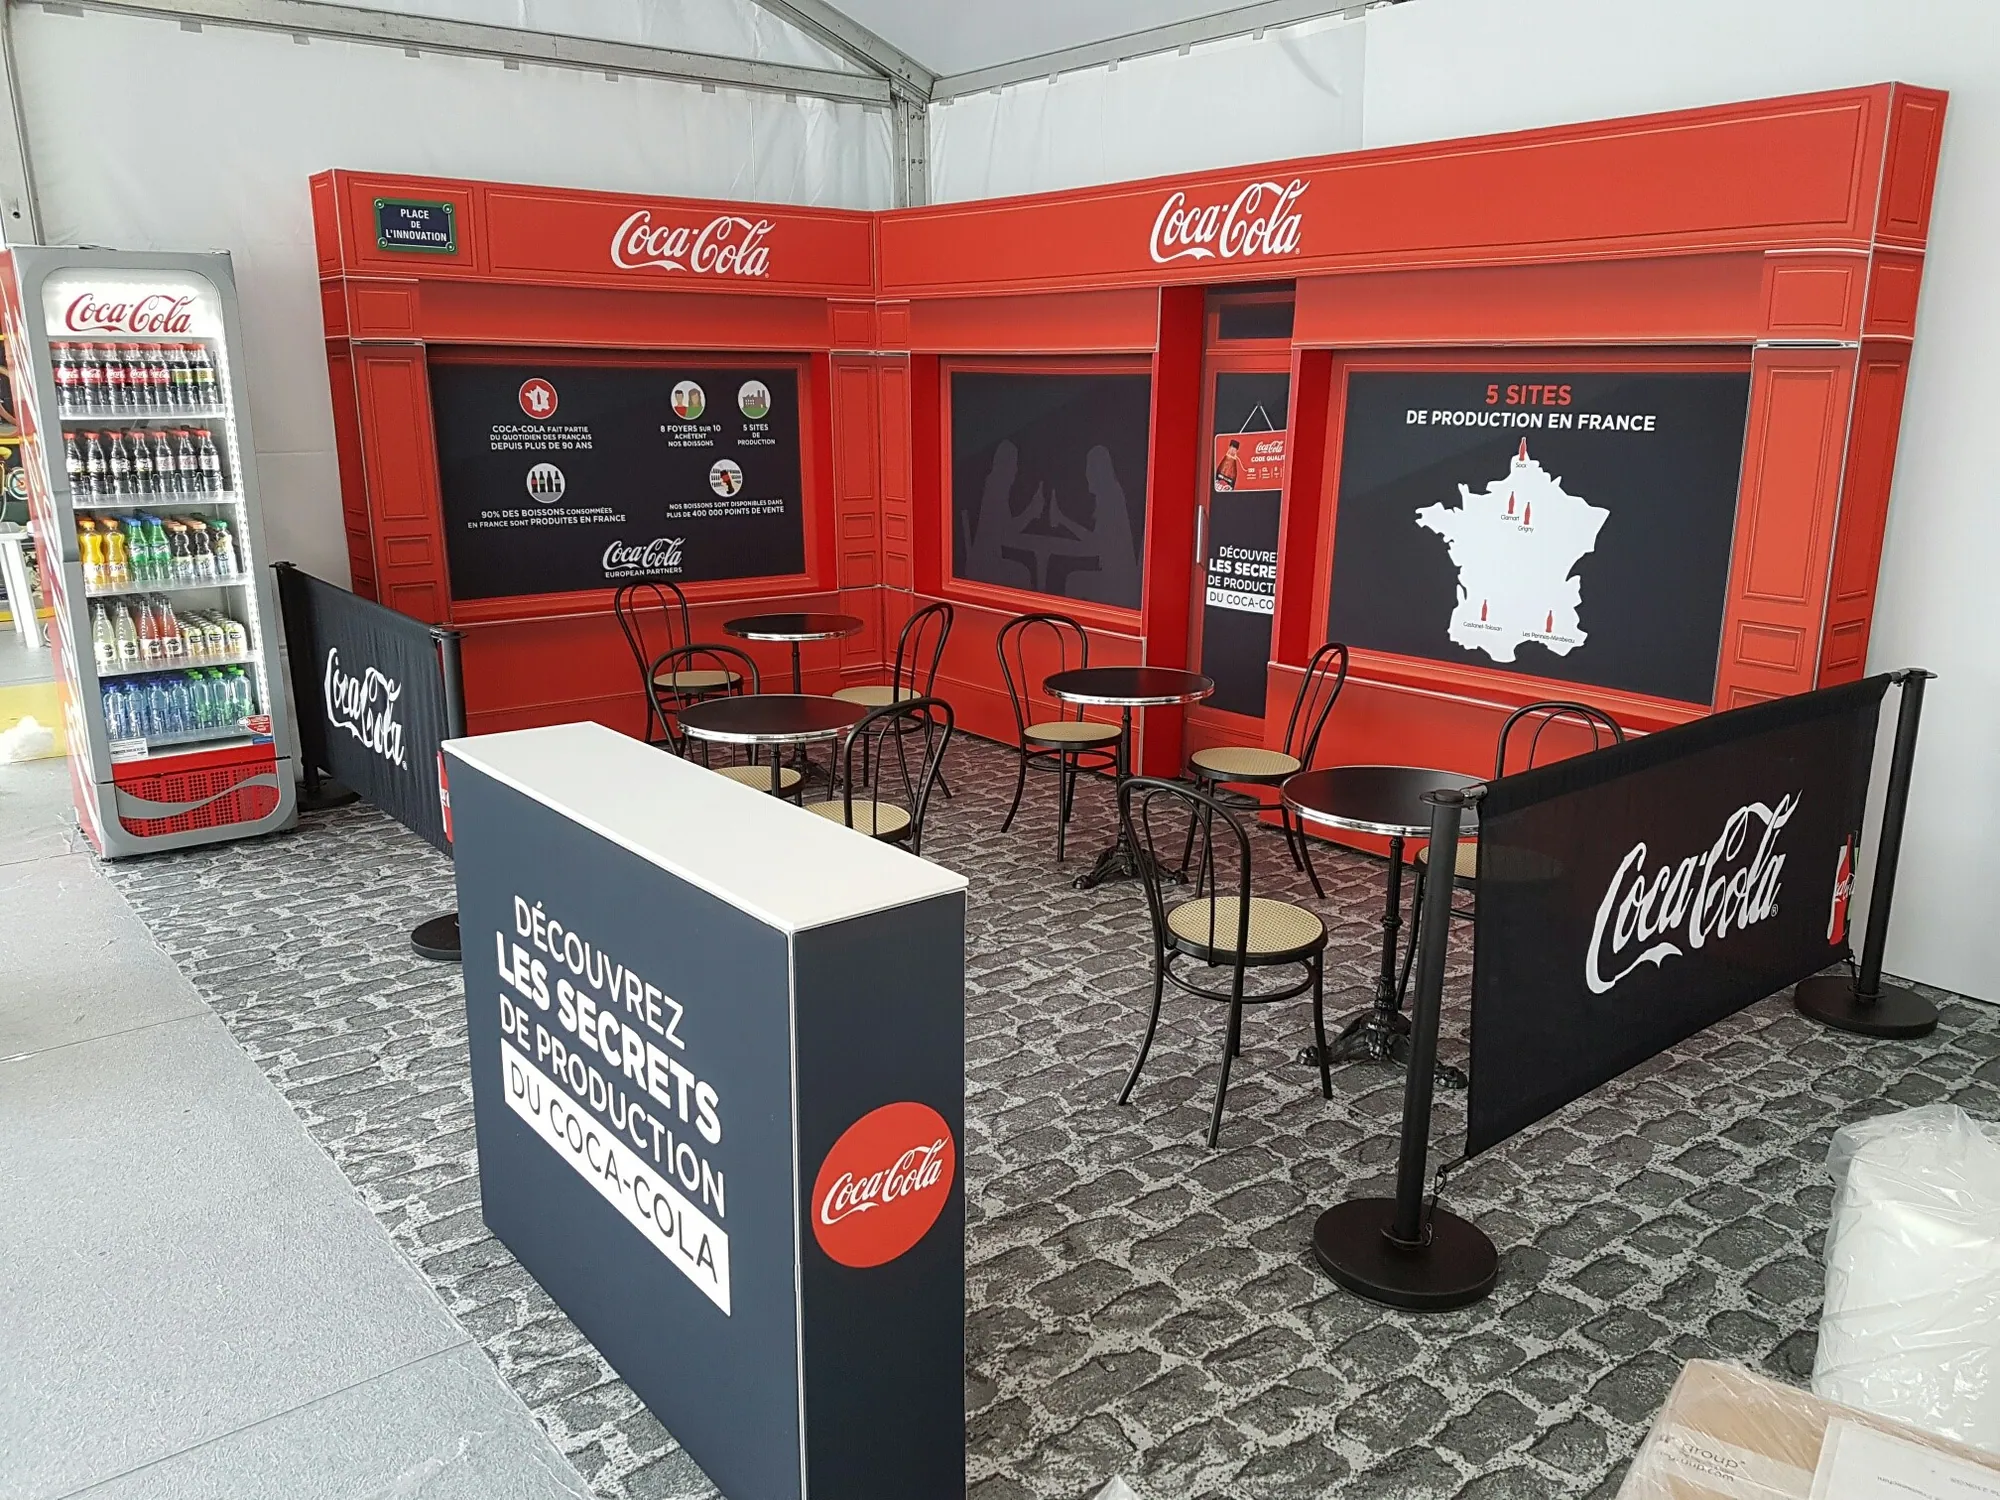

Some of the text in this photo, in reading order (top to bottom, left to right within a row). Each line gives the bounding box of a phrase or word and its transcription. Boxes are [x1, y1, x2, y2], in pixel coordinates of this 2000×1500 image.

[400, 208, 430, 219] PLACE
[1150, 178, 1311, 263] Coca-Cola
[410, 220, 421, 229] DE
[385, 228, 447, 242] L'INNOVATION
[610, 210, 776, 277] Coca-Cola
[65, 292, 197, 333] Coca-Cola
[1485, 384, 1572, 406] 5 SITES
[492, 425, 546, 433] COCA-COLA
[660, 425, 666, 433] 8
[667, 424, 698, 432] FOYERS
[712, 424, 721, 432] 10
[1406, 410, 1656, 431] DE PRODUCTION EN FRANCE
[491, 442, 522, 450] DEPUIS
[575, 441, 593, 449] ANS
[502, 433, 541, 441] QUOTIDIEN
[542, 433, 557, 441] DES
[557, 433, 592, 442] FRANÇAIS
[737, 438, 776, 446] PRODUCTION
[481, 506, 613, 519] 90% DES BOISSONS CONSOMMÉES
[531, 516, 578, 526] PRODUITES
[593, 514, 626, 522] FRANCE
[724, 508, 750, 516] POINTS
[751, 507, 761, 515] DE
[762, 505, 785, 514] VENTE
[602, 537, 686, 570] Coca-Cola
[1219, 545, 1278, 563] DÉCOUVRE
[605, 567, 683, 578] EUROPEAN PARTNERS
[1209, 558, 1276, 579] LES SECRE
[1207, 574, 1221, 586] DE
[1209, 591, 1274, 610] DU COCA-CO
[324, 647, 404, 766] Coca-Cola
[1585, 789, 1803, 995] Coca-Cola
[514, 894, 685, 1050] DÉCOUVREZ
[496, 930, 722, 1145] LES SECRETS
[499, 992, 725, 1218] DE PRODUCTION
[510, 1060, 718, 1284] DU COCA-COLA
[820, 1135, 950, 1225] Coca-Cola
